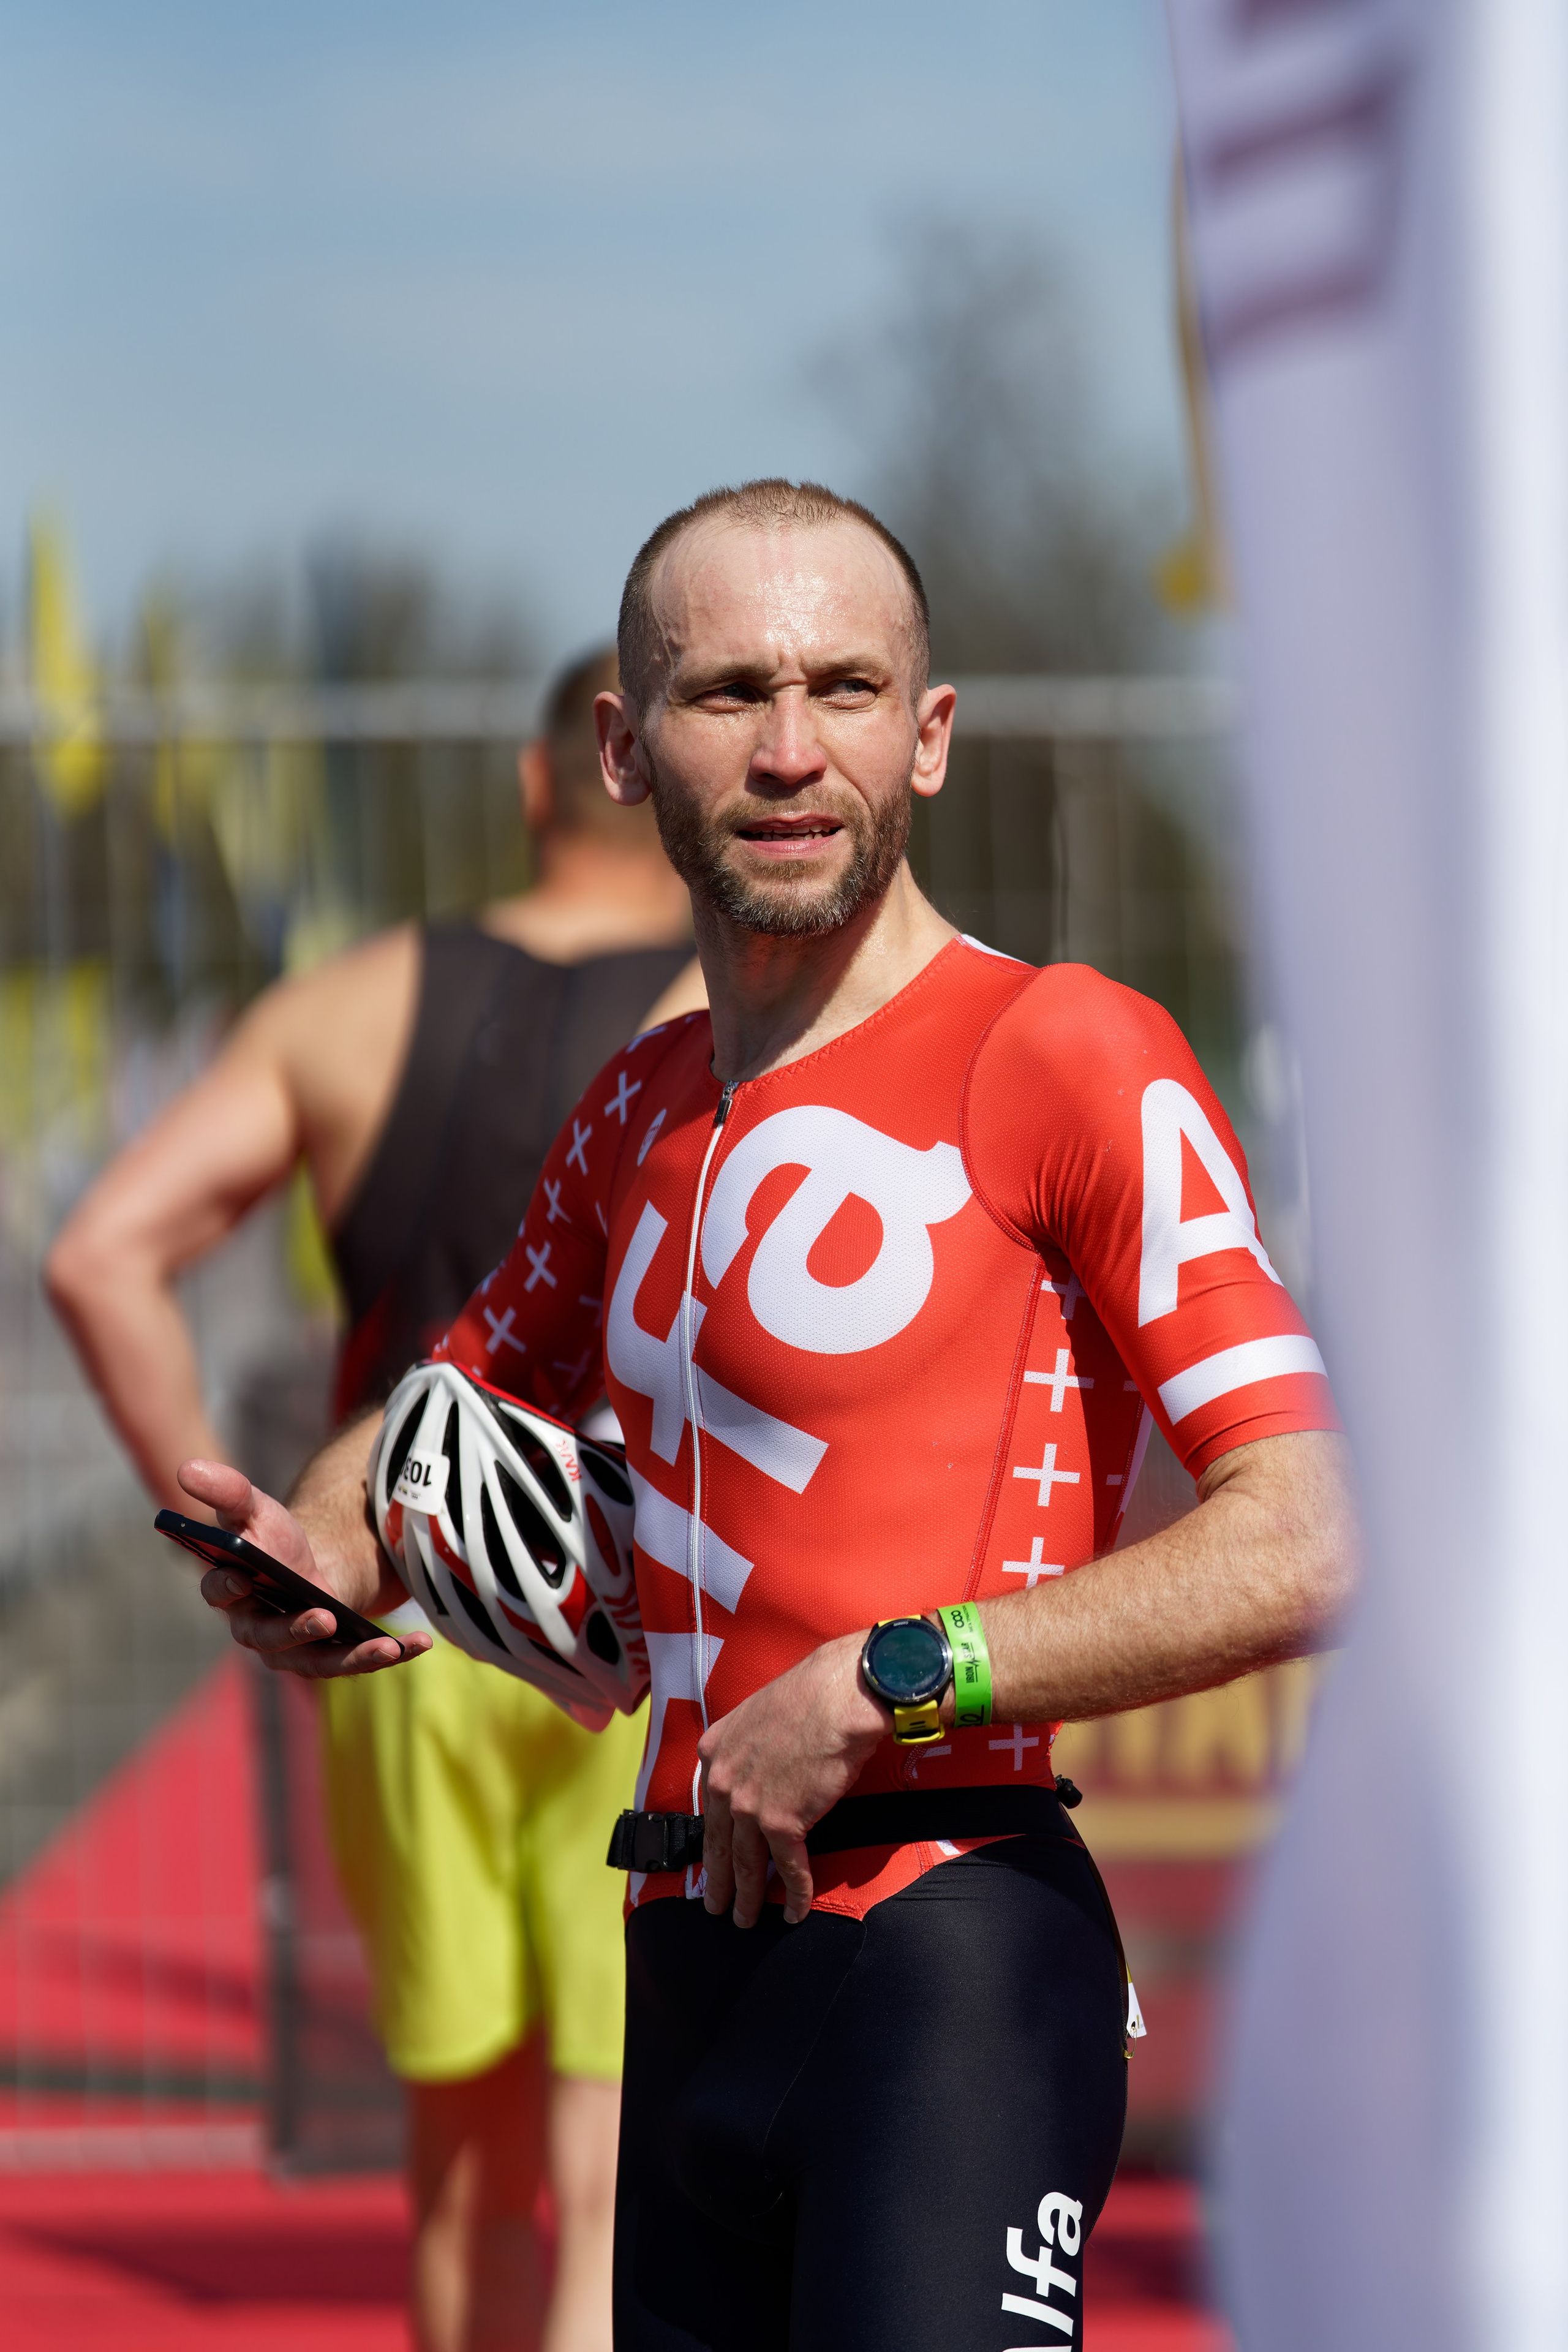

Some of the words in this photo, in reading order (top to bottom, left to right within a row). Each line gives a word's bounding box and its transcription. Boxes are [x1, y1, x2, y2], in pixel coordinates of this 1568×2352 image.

[1138, 1078, 1285, 1328] A
[965, 1666, 975, 1683] IRON
[1000, 2191, 1083, 2352] lfa
